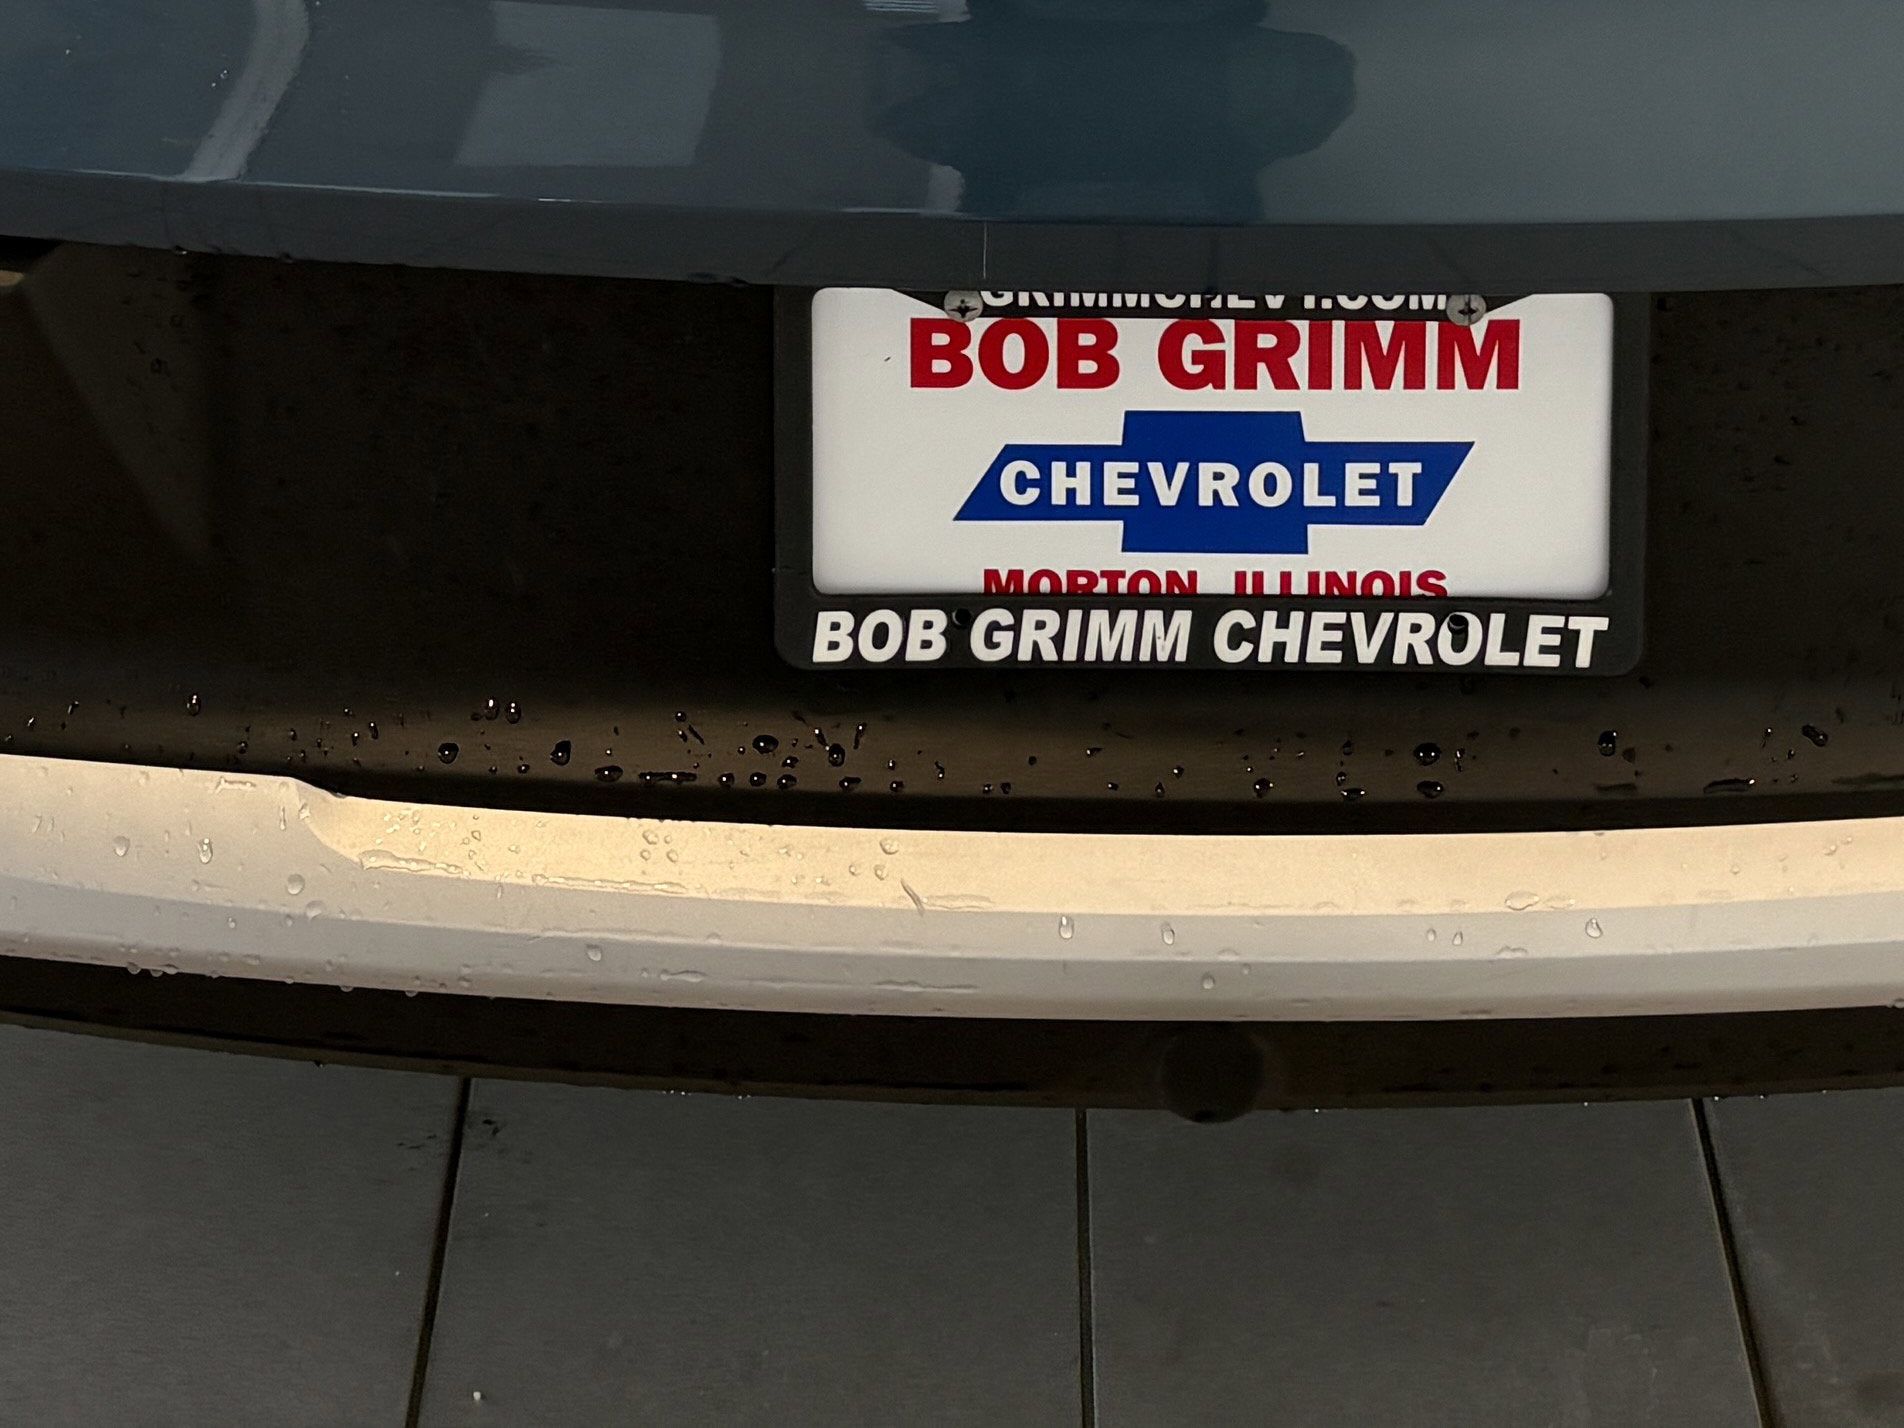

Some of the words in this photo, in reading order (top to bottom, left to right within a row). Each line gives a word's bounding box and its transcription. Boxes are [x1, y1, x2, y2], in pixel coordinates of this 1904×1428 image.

[910, 317, 1121, 390] BOB
[1157, 317, 1520, 391] GRIMM
[999, 459, 1423, 508] CHEVROLET
[811, 609, 947, 663] BOB
[969, 609, 1190, 663] GRIMM
[1213, 609, 1610, 669] CHEVROLET
